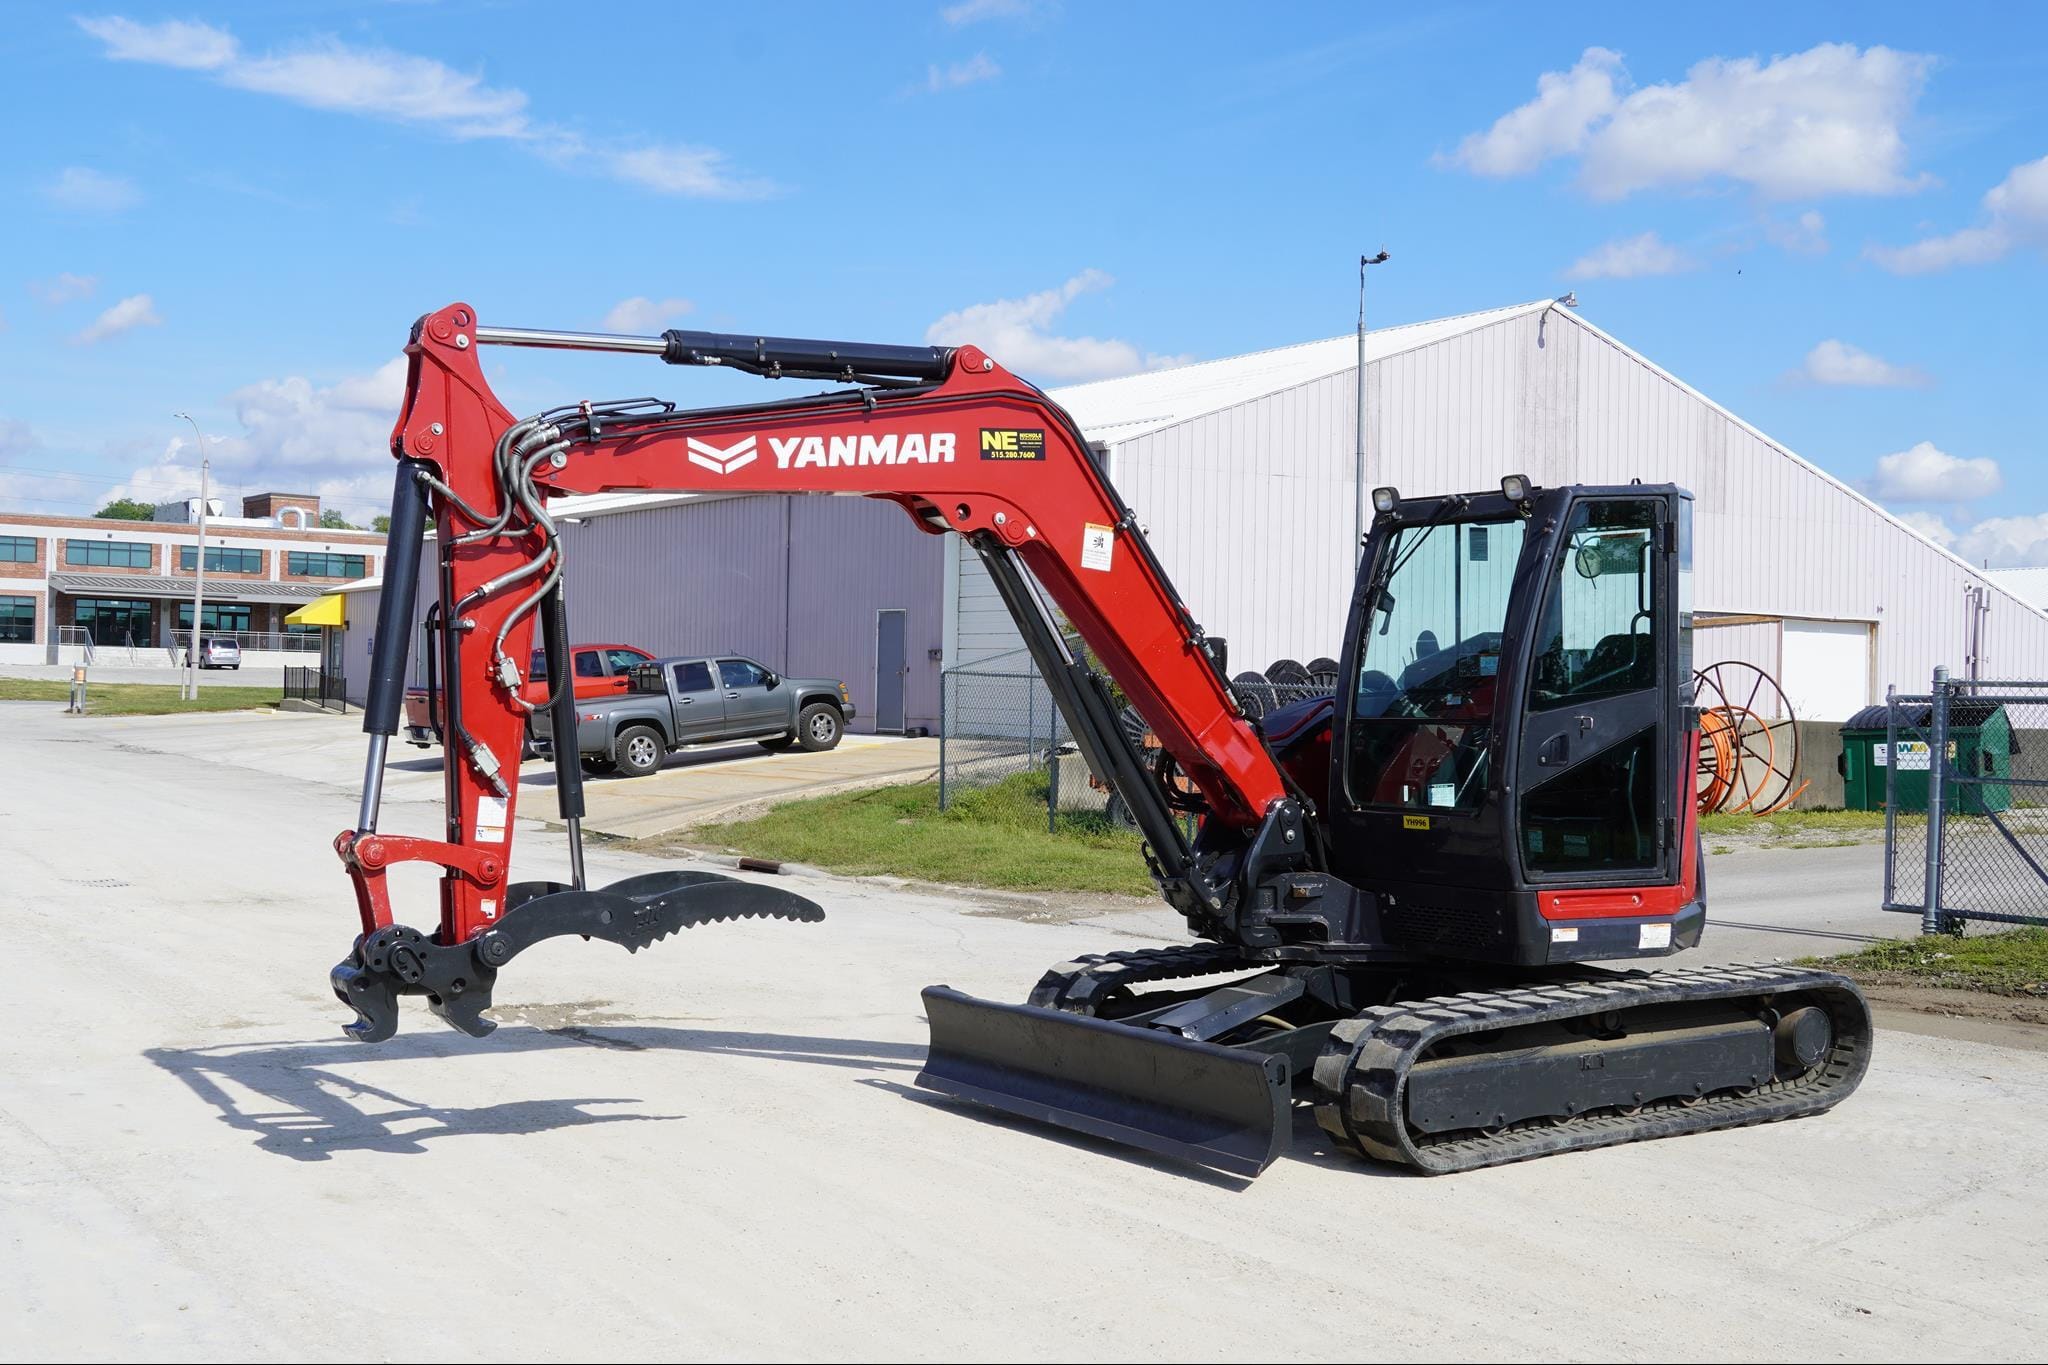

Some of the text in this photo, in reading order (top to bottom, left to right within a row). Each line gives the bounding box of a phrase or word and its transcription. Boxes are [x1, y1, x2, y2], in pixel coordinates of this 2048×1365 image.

[981, 431, 1018, 450] NE
[768, 432, 956, 469] YANMAR
[1406, 818, 1427, 827] YH996
